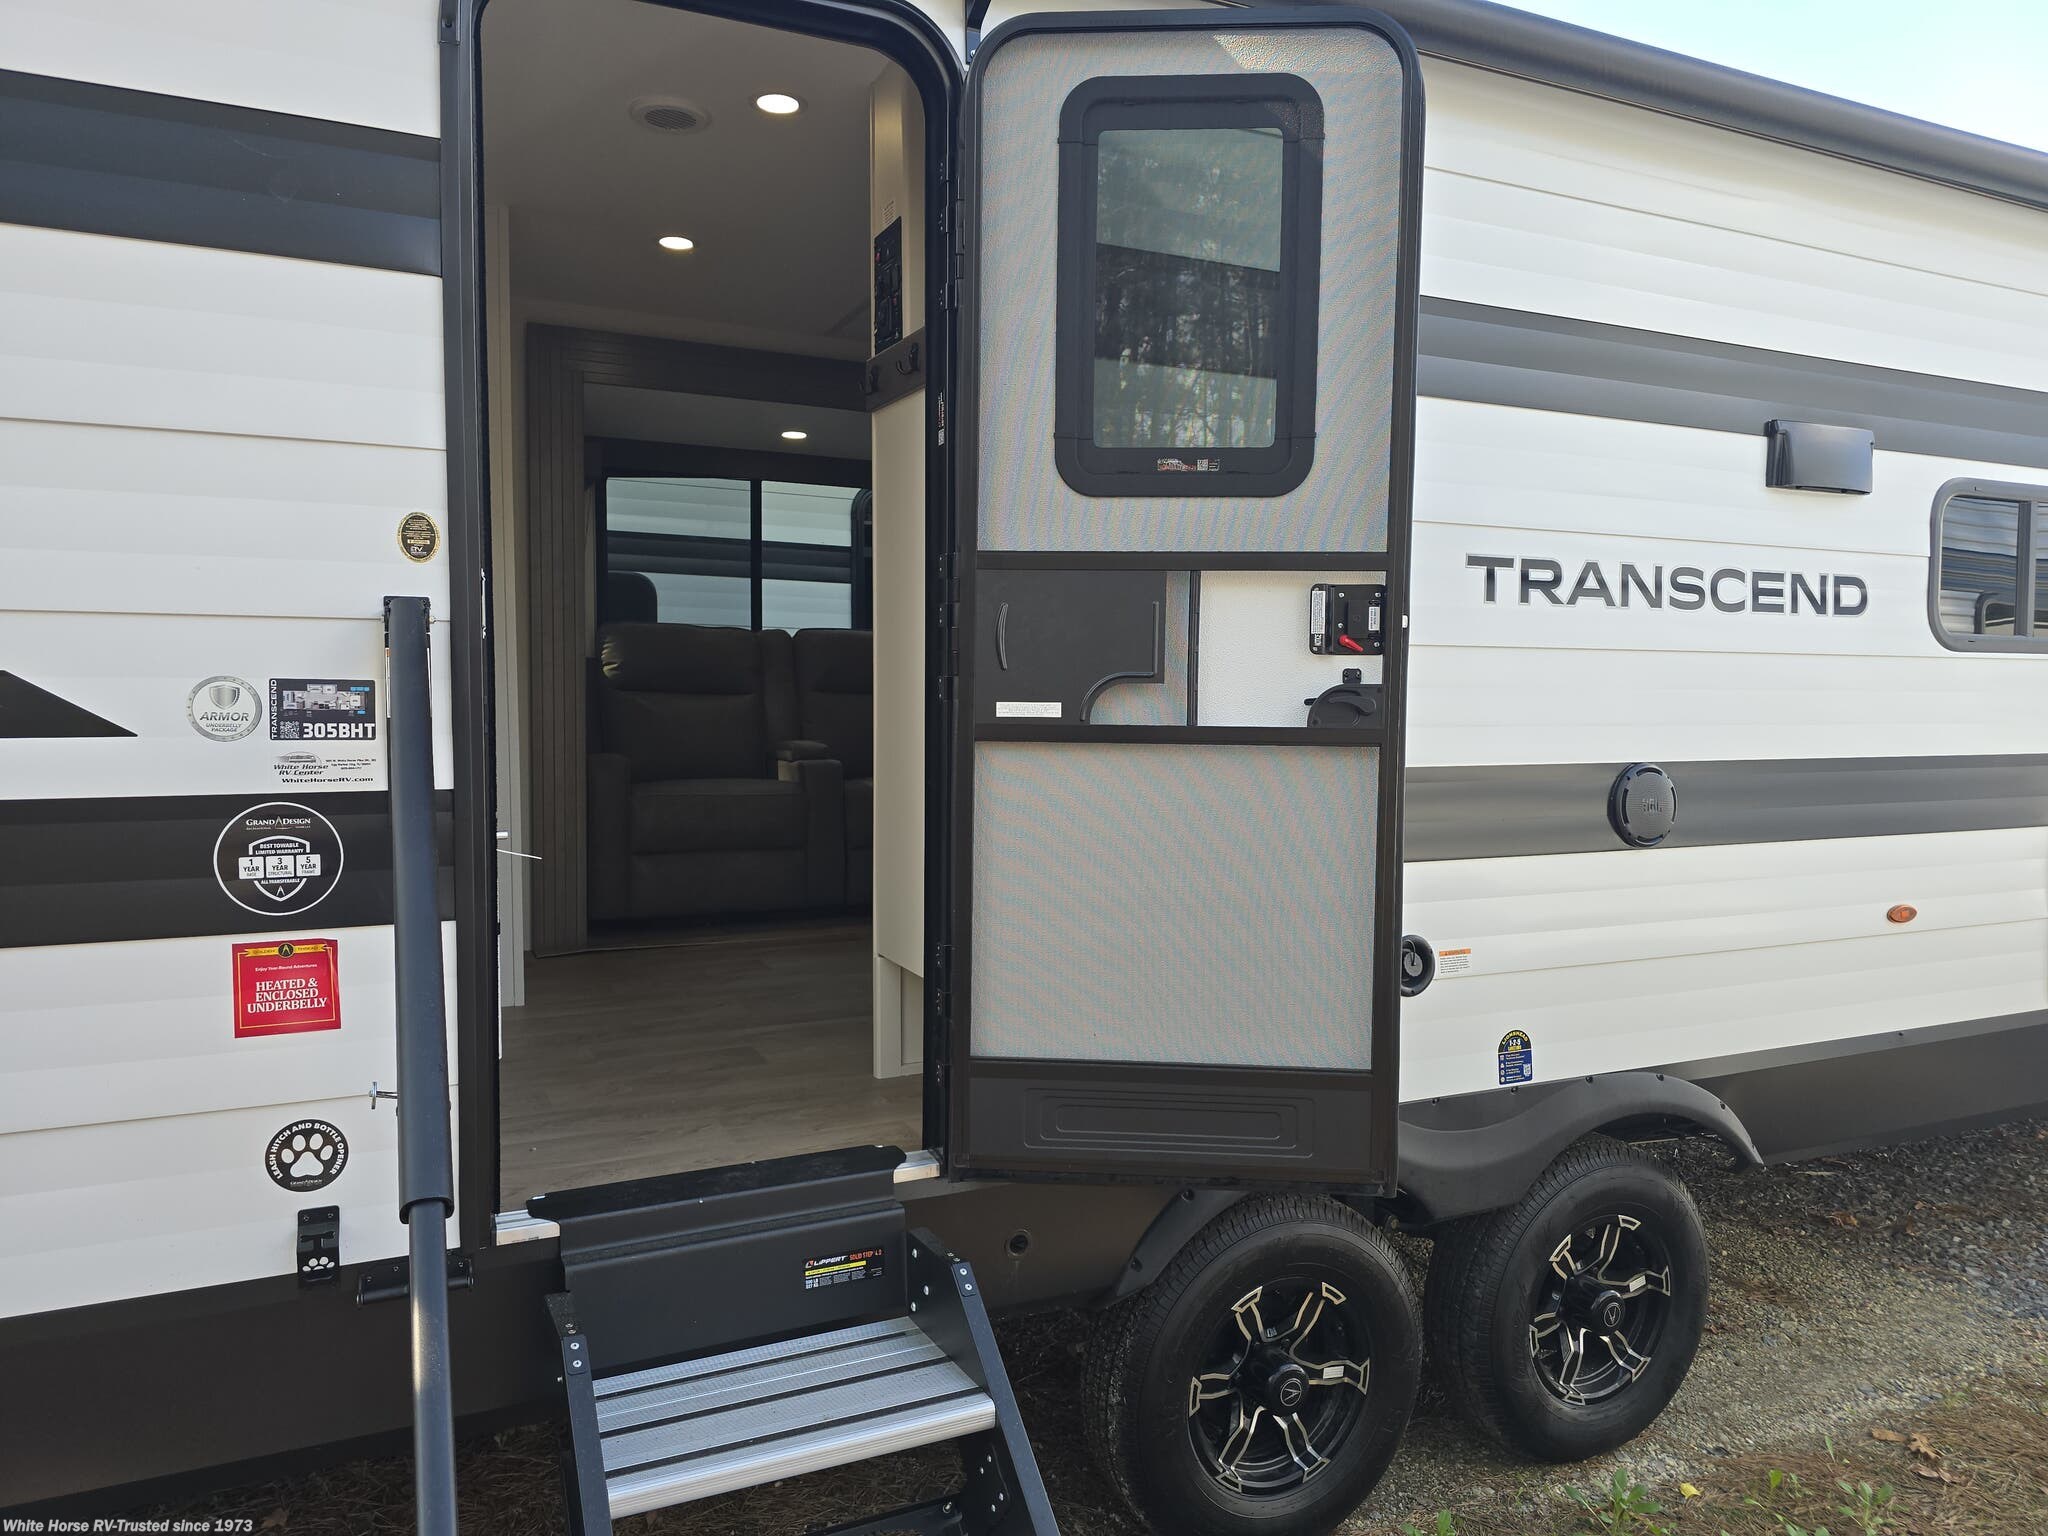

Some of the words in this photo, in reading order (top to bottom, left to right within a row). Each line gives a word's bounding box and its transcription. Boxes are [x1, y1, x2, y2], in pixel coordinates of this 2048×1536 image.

[1466, 554, 1869, 617] TRANSCEND
[200, 712, 249, 721] ARMOR
[270, 680, 278, 739] TRANSCEND
[303, 722, 375, 738] 305BHT
[249, 858, 253, 866] 1
[277, 857, 283, 865] 3
[306, 856, 311, 864] 5
[256, 979, 305, 991] HEATED
[308, 977, 318, 987] &
[256, 988, 318, 1002] ENCLOSED
[247, 997, 327, 1013] UNDERBELLY
[292, 1122, 312, 1132] AND
[314, 1122, 341, 1142] BOTTLE
[271, 1129, 291, 1152] HITCH
[329, 1142, 345, 1174] OPENER
[269, 1154, 283, 1179] LEASH
[814, 1255, 848, 1266] LIPPERT
[863, 1250, 873, 1258] STEP
